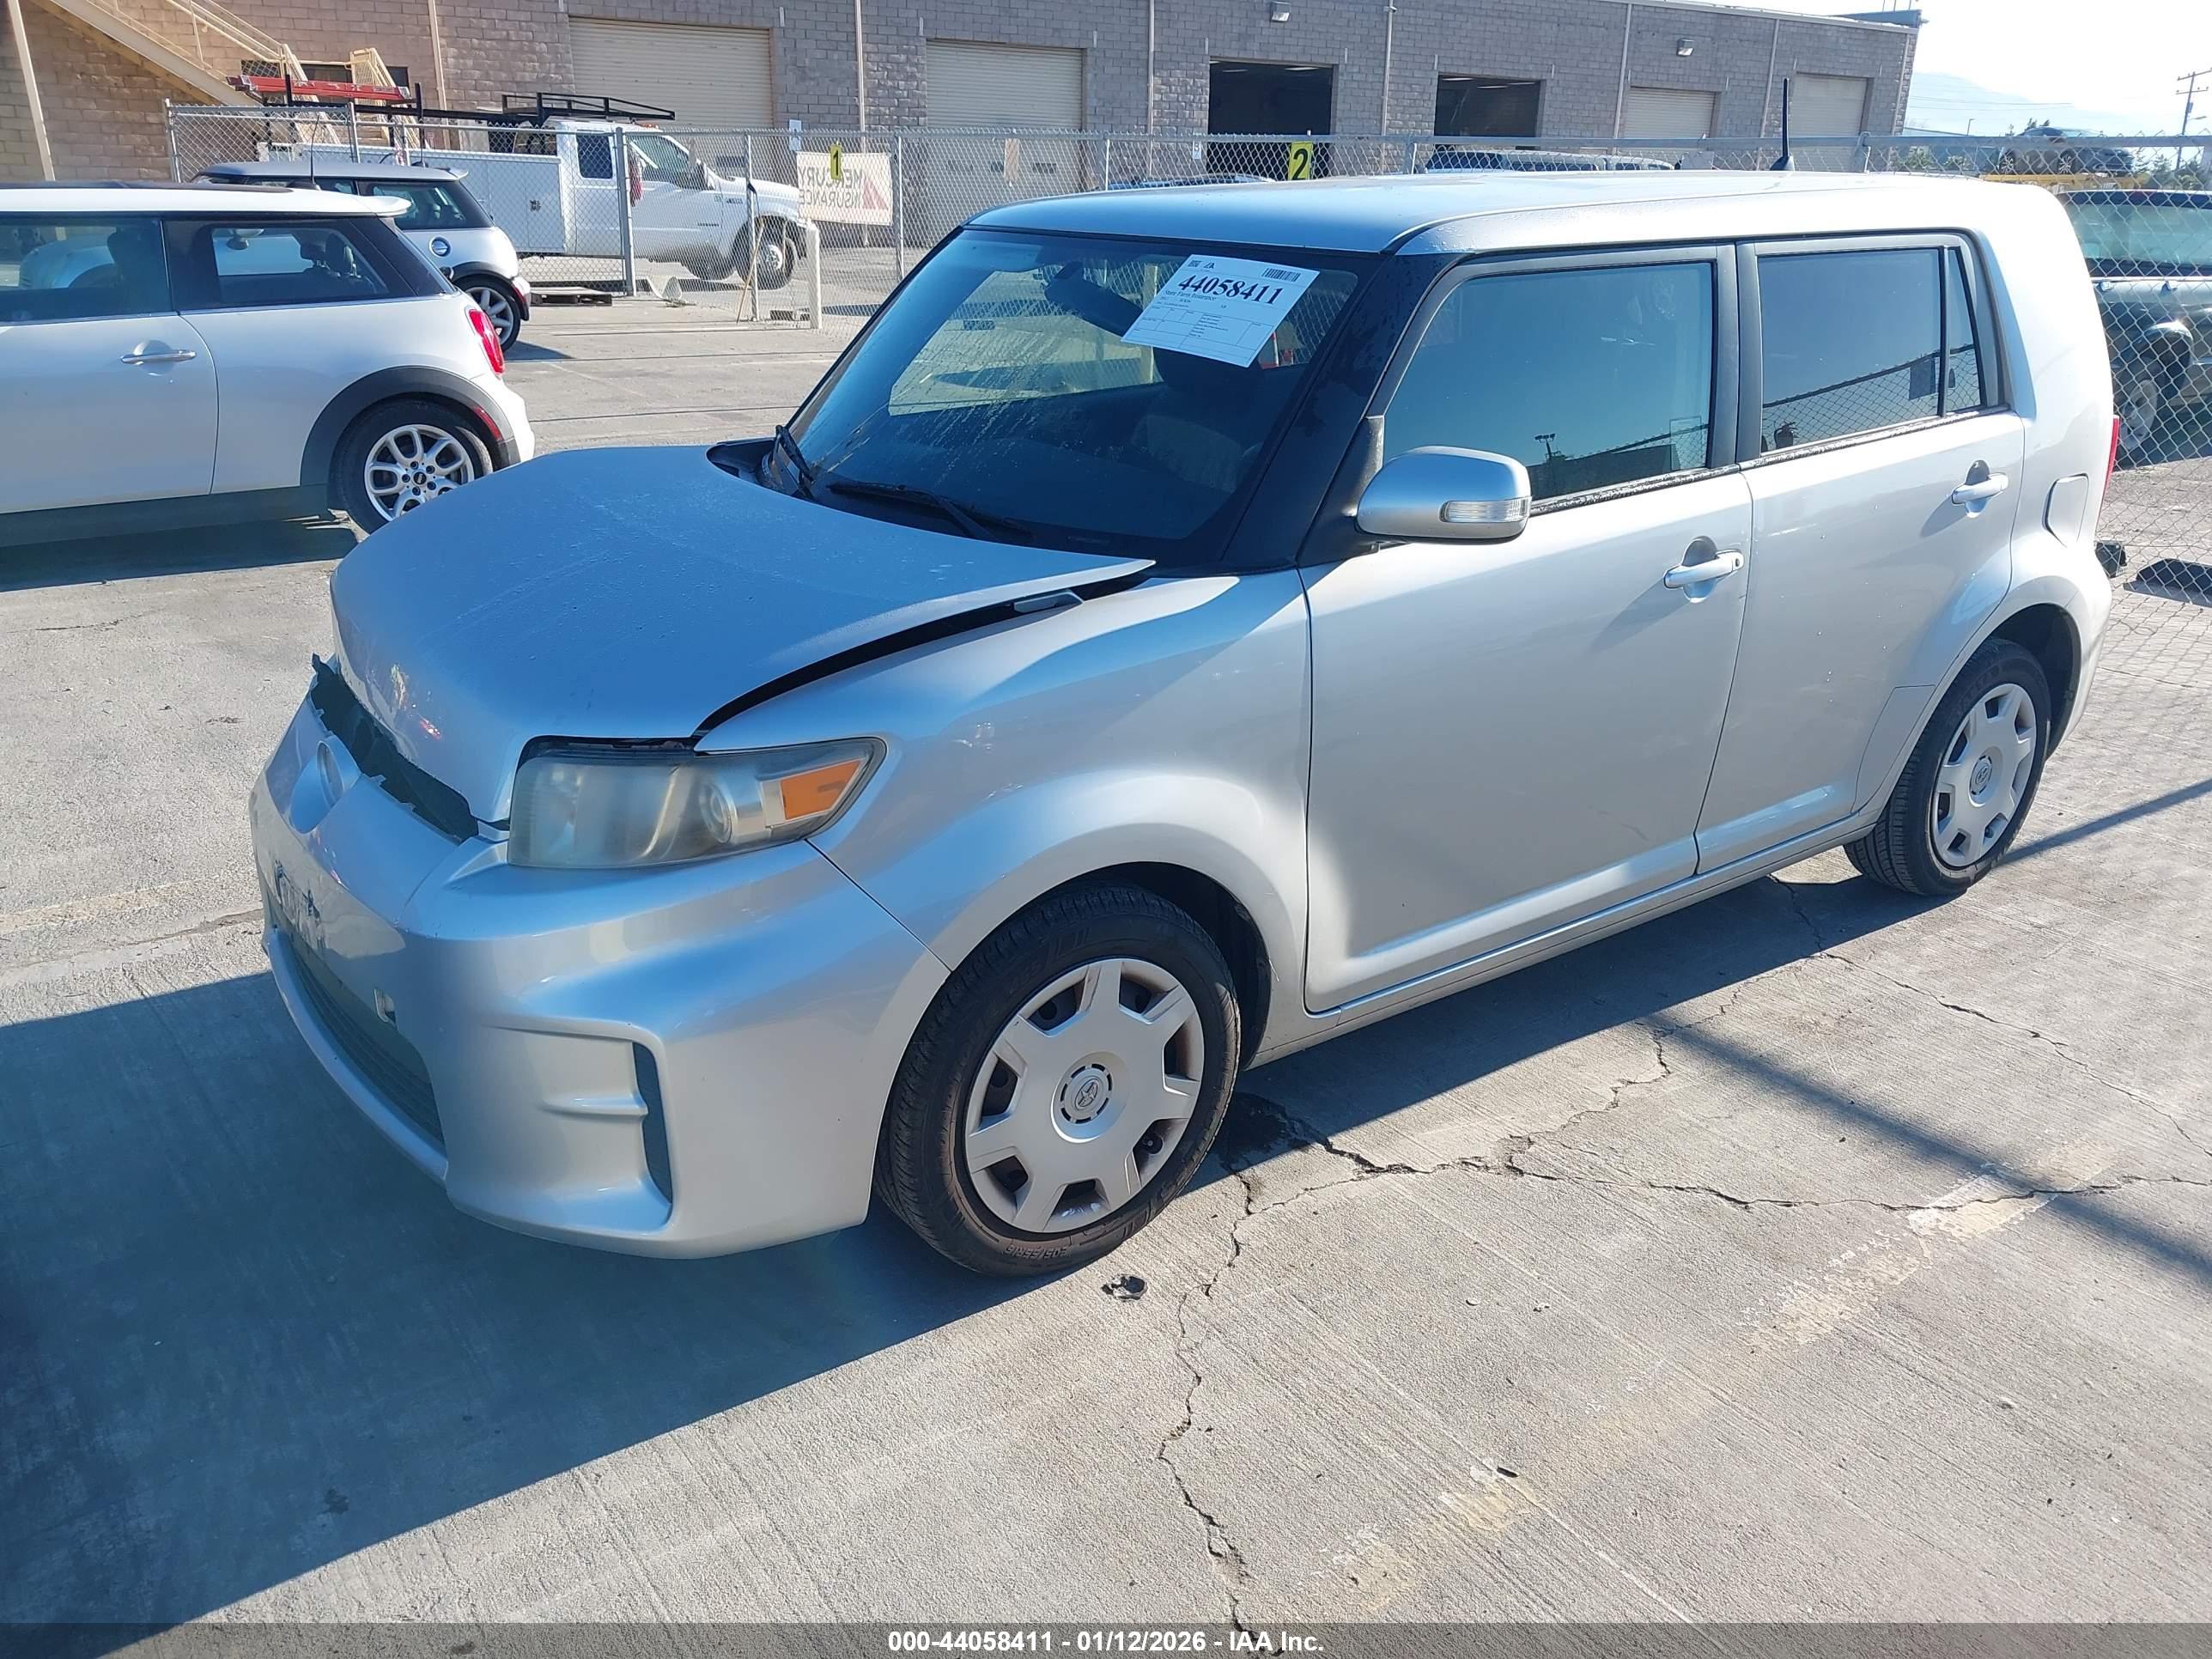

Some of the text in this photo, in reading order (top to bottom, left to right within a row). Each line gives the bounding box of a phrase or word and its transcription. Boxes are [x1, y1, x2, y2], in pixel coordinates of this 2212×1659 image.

[833, 150, 838, 176] 1
[1291, 148, 1308, 179] 2
[1178, 275, 1284, 304] 44058411
